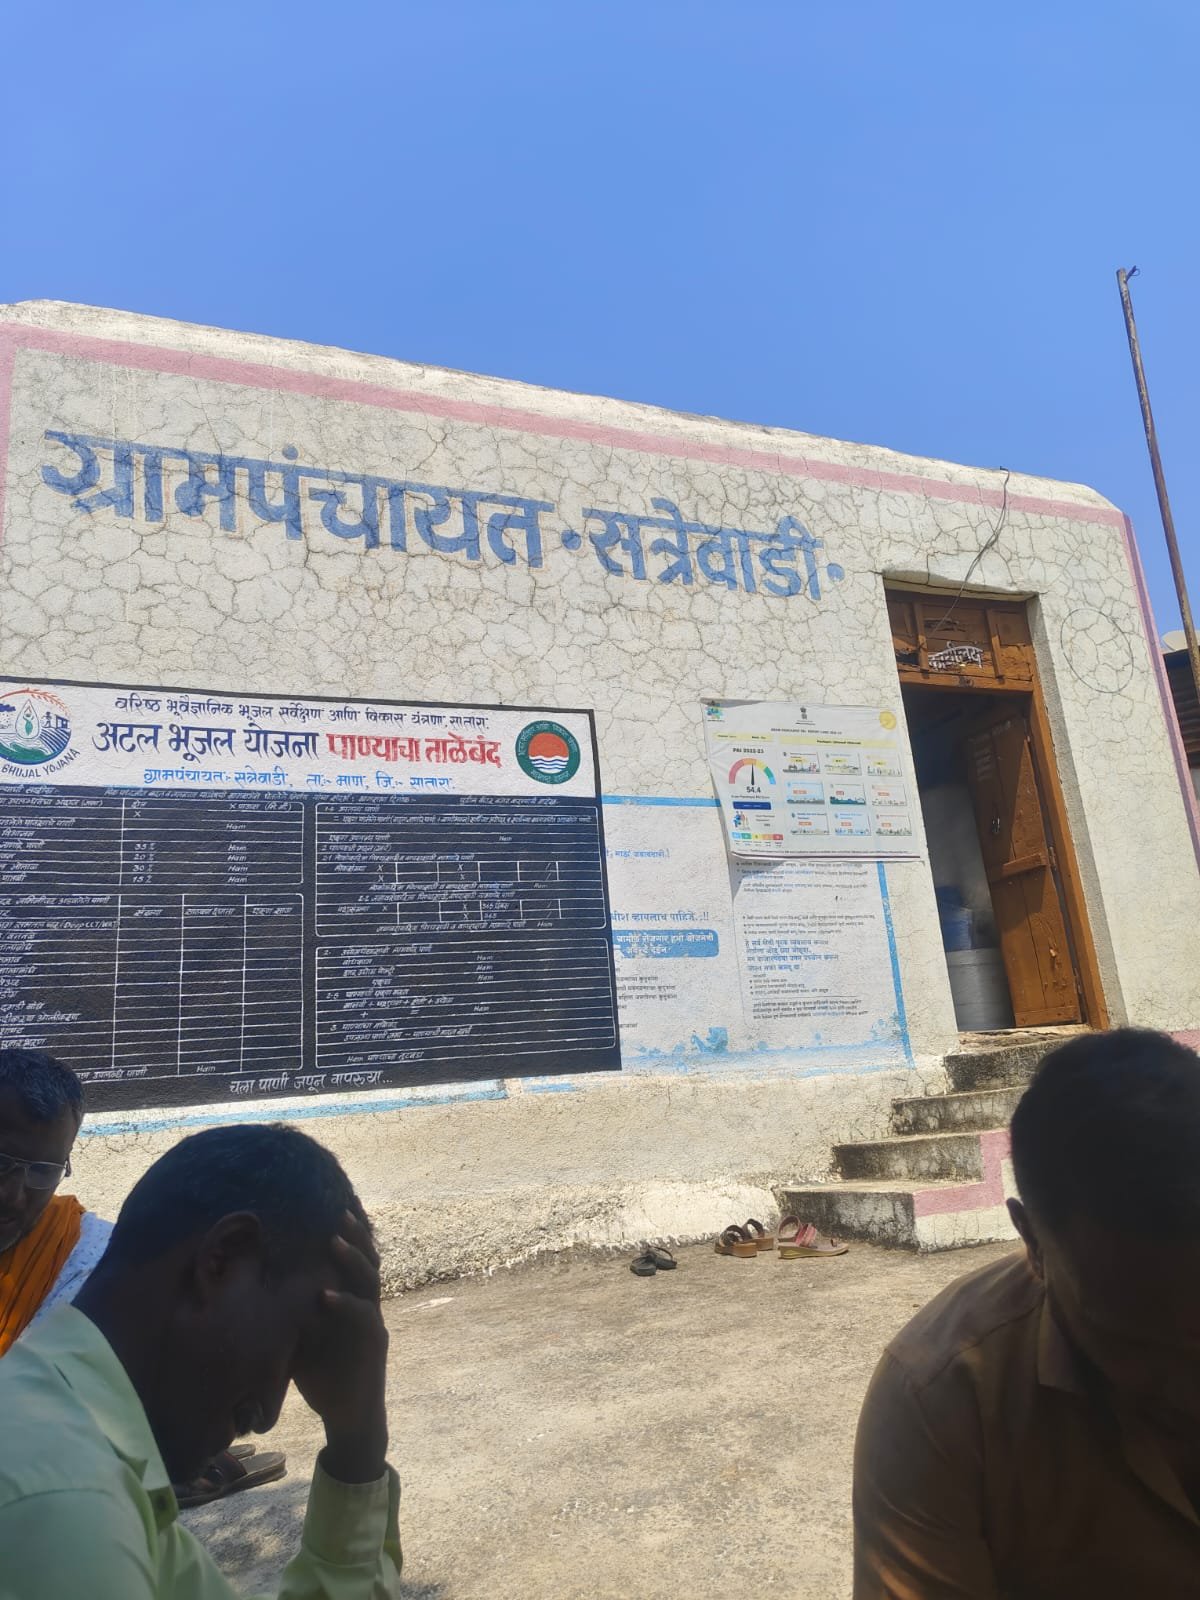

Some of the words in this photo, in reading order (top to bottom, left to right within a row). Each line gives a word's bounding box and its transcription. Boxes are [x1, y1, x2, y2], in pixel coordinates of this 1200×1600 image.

[41, 430, 555, 567] ग्रामपंचायत
[115, 692, 162, 716] वरिष्ठ
[238, 703, 274, 722] भूजल
[329, 705, 360, 722] आणि
[366, 707, 407, 727] विकास
[92, 722, 162, 754] अटल
[169, 723, 236, 763] भूजल
[243, 723, 320, 759] योजना
[326, 731, 421, 763] पाण्याचा
[425, 731, 502, 767] ताळेबंद
[43, 748, 80, 775] YOJANA
[197, 1064, 216, 1073] Ham
[229, 1080, 253, 1095] चला
[258, 1072, 289, 1092] पाणी
[294, 1074, 326, 1093] जपून
